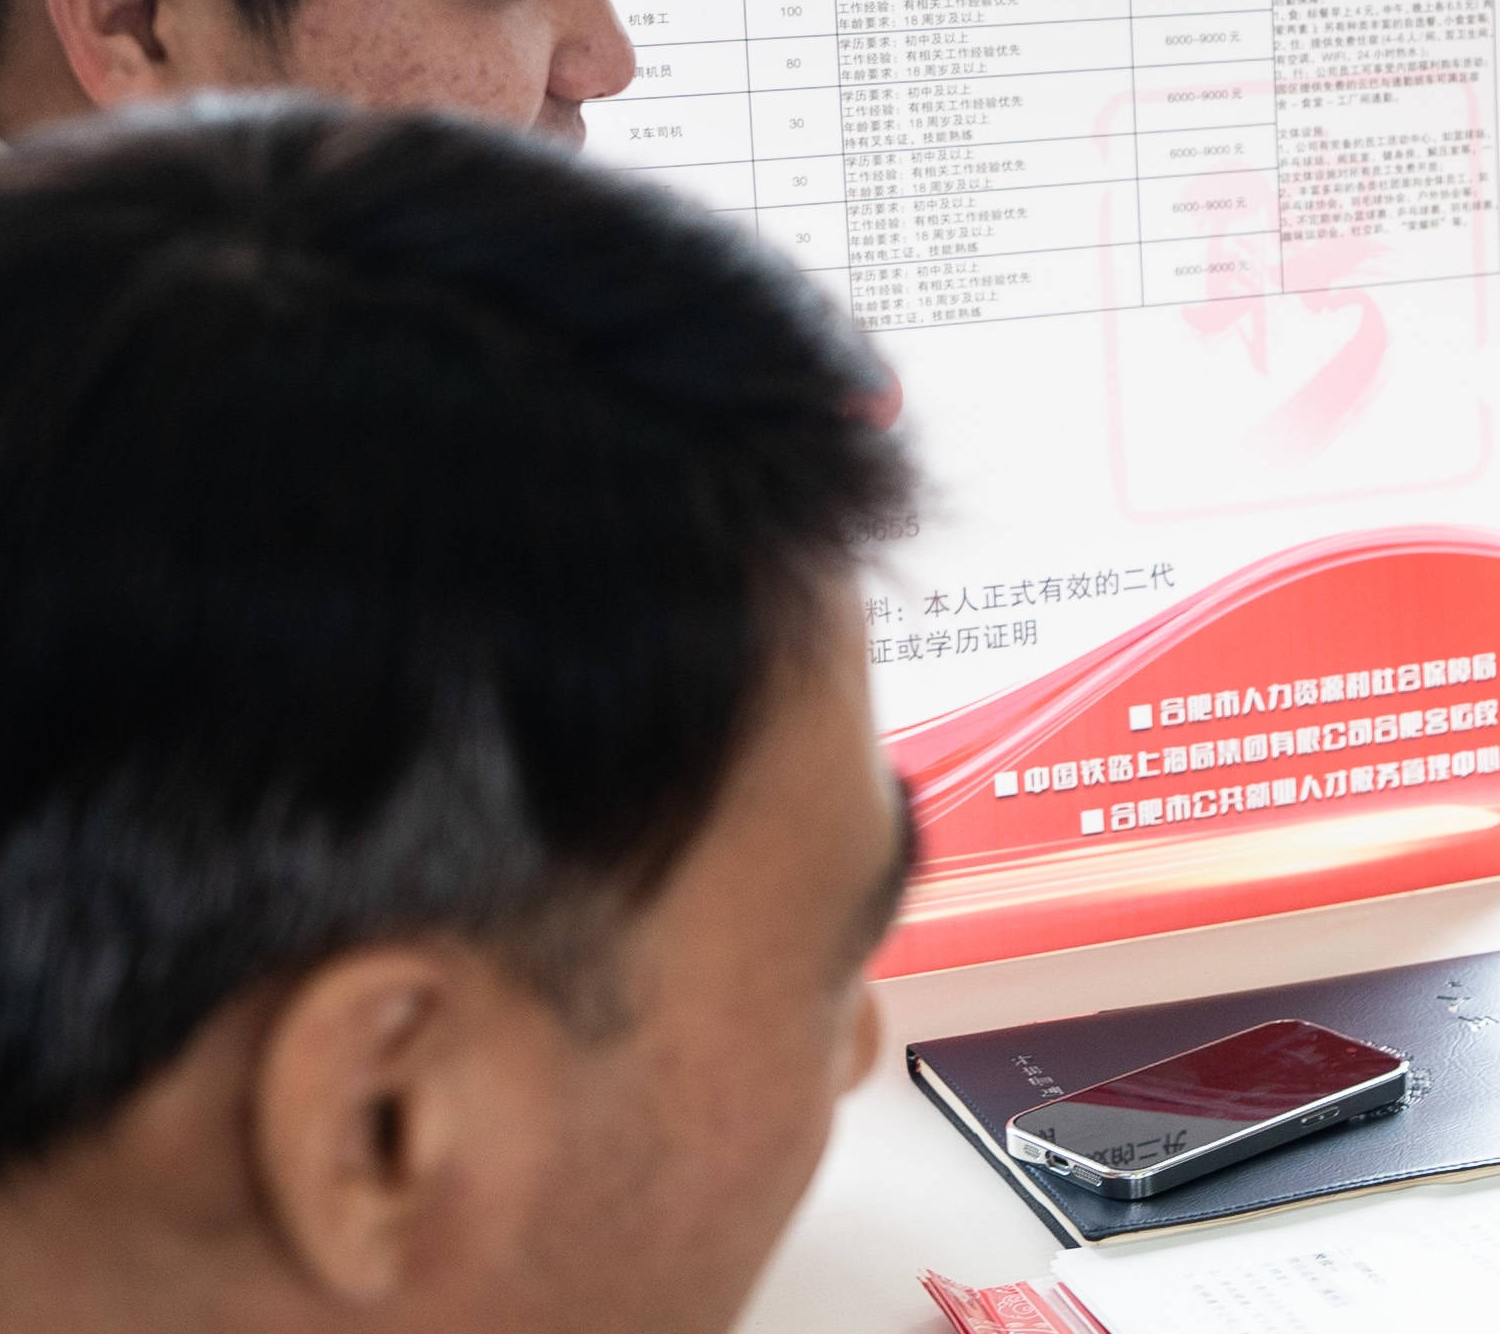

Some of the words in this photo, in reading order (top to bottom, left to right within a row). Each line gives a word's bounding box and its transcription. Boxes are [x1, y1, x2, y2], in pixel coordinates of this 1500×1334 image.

[781, 6, 802, 17] 100
[629, 13, 669, 26] 机修工
[786, 58, 801, 68] 80
[789, 119, 804, 129] 30
[629, 126, 683, 140] 叉车司机
[792, 176, 807, 187] 30
[796, 232, 811, 243] 30
[868, 618, 1039, 665] 证或学历证明
[1159, 652, 1498, 728] 合肥市人力资源和社会保障局
[1024, 699, 1500, 796] 中国铁路上海局集团有限公司合肥客运段
